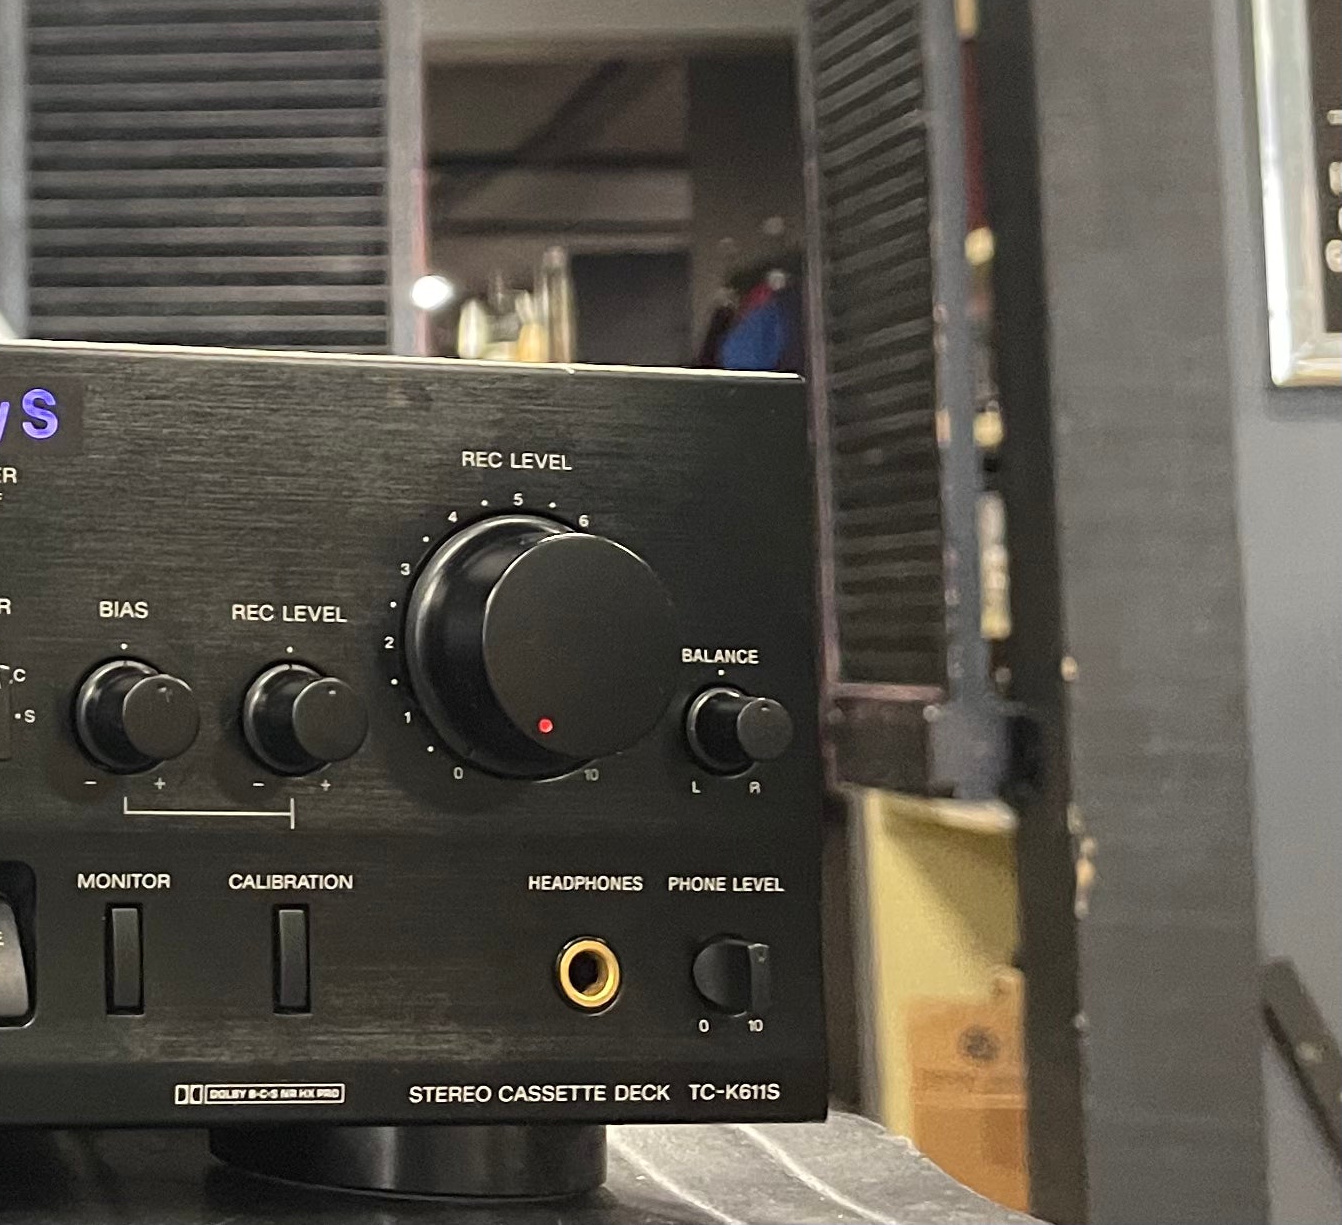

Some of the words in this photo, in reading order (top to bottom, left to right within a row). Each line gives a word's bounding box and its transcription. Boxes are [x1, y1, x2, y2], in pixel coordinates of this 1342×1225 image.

[22, 387, 59, 440] S
[461, 450, 503, 469] REC
[510, 452, 573, 471] LEVEL
[513, 492, 524, 506] 5
[447, 511, 458, 523] 4
[578, 514, 590, 528] 6
[400, 562, 411, 576] 3
[99, 600, 149, 619] BIAS
[231, 603, 275, 622] REC
[282, 605, 348, 623] LEVEL
[384, 636, 395, 649] 2
[681, 647, 760, 665] BALANCE
[13, 668, 26, 683] C
[24, 709, 36, 724] S
[404, 711, 411, 724] 1
[453, 766, 464, 780] 0
[583, 768, 599, 782] 10
[691, 780, 701, 794] L
[749, 781, 761, 794] R
[77, 873, 171, 889] MONITOR
[228, 873, 353, 890] CALIBRATION
[528, 875, 644, 892] HEADPHONES
[668, 876, 727, 892] PHONE
[732, 876, 785, 892] LEVEL
[698, 1019, 710, 1033] 0
[747, 1019, 764, 1032] 10
[209, 1089, 247, 1099] DOLBY
[316, 1088, 340, 1098] PRO
[408, 1085, 492, 1104] STEREO
[498, 1084, 607, 1103] CASSETTE
[614, 1083, 671, 1102] DECK
[688, 1083, 781, 1101] TC-K611S
